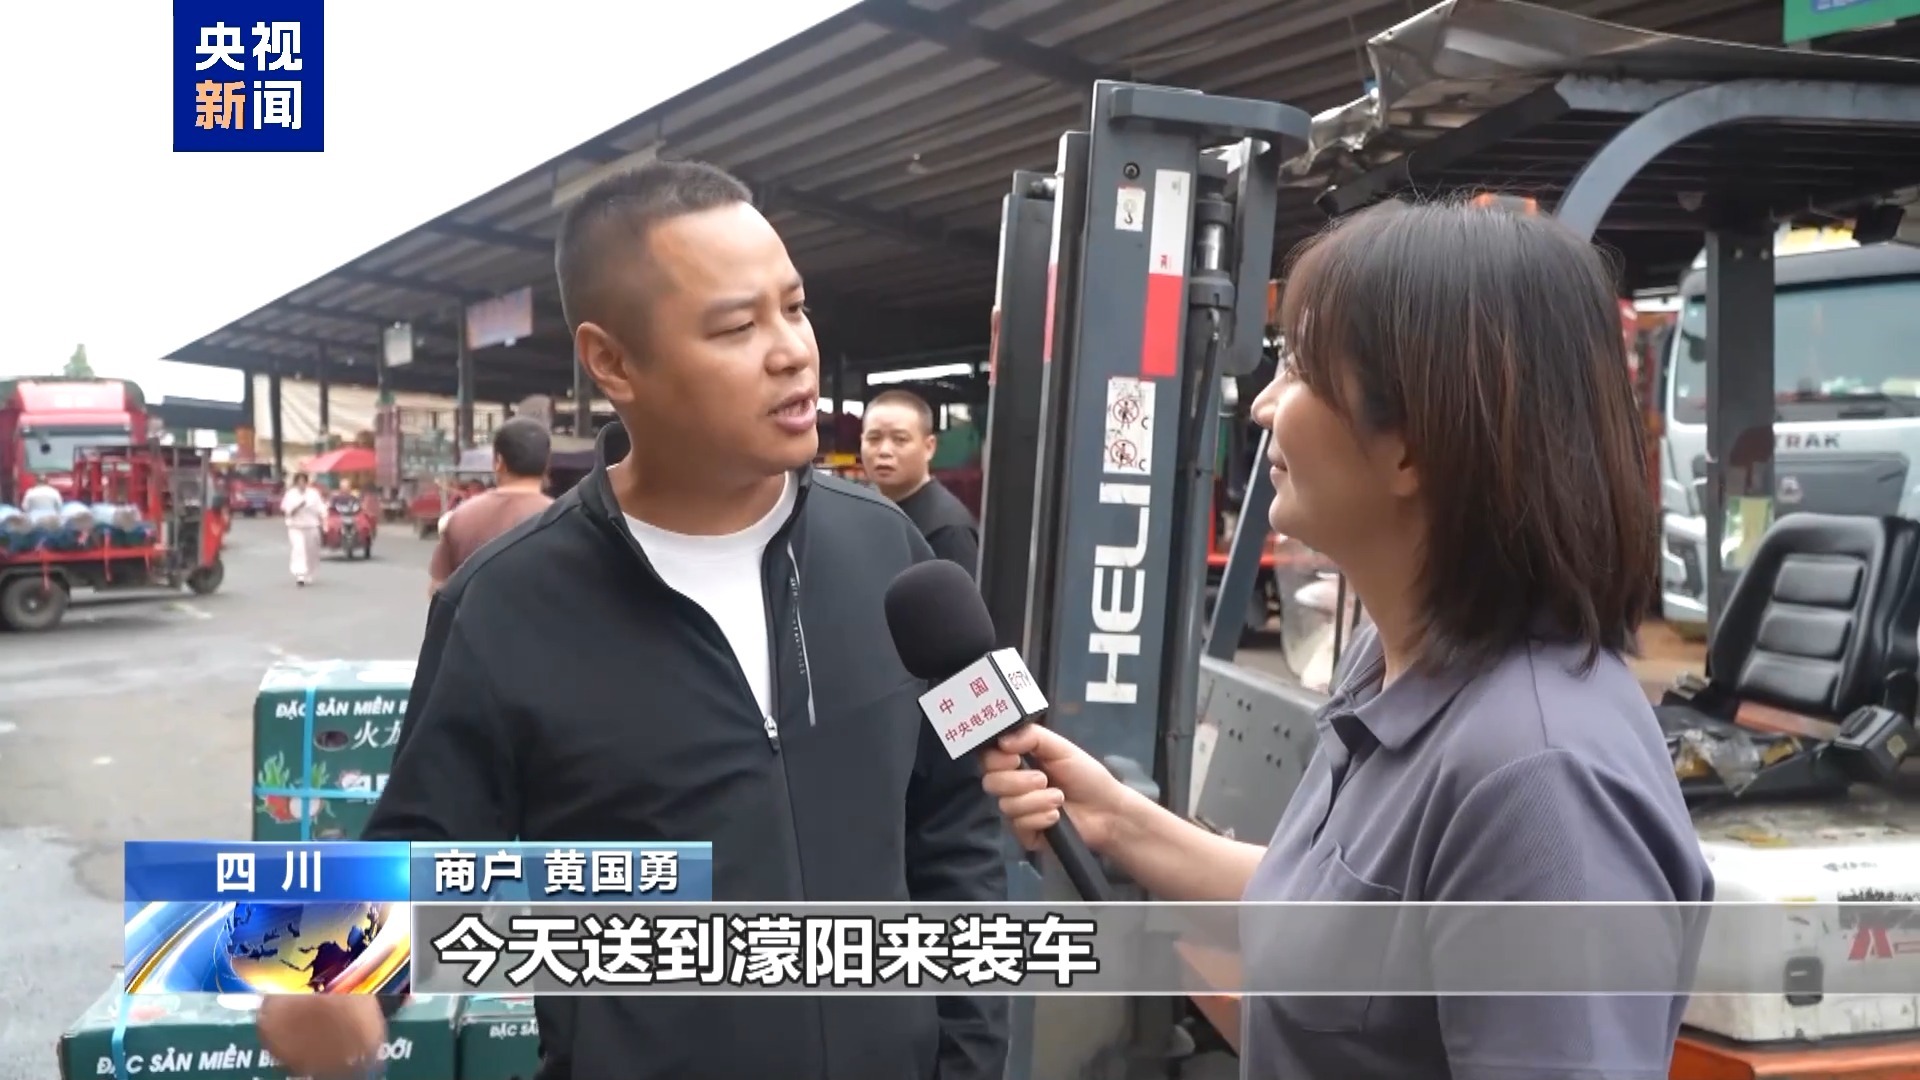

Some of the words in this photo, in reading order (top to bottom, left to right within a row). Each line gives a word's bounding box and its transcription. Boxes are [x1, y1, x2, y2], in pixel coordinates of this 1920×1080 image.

[1085, 481, 1152, 704] HELI
[939, 676, 990, 714] 中国
[945, 699, 1009, 742] 中央电视台
